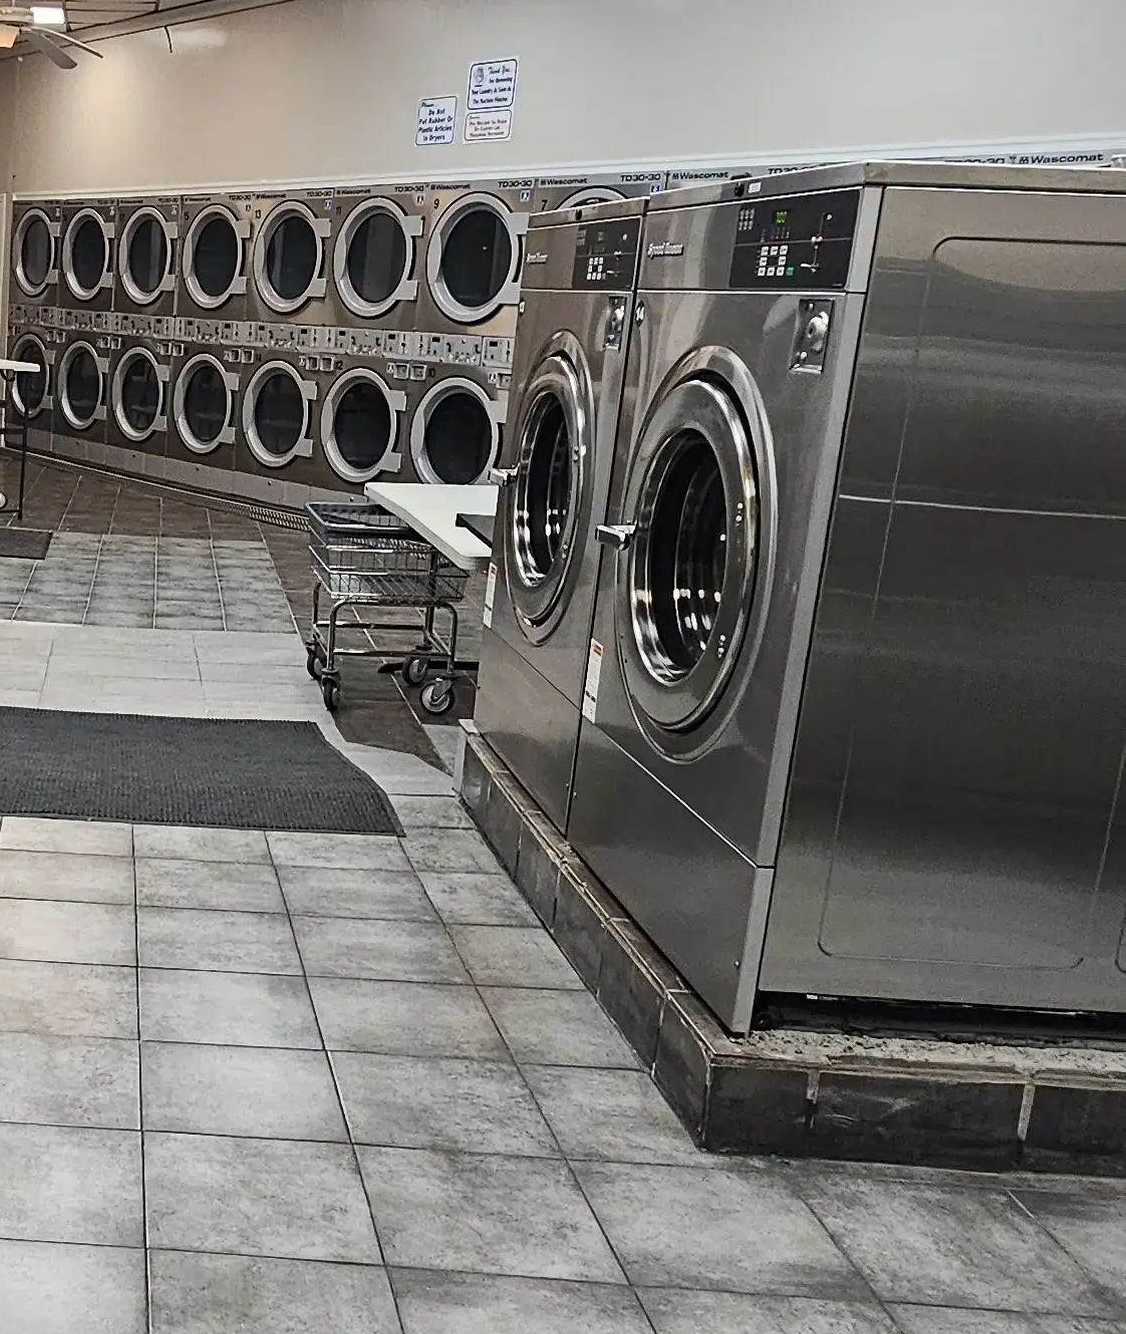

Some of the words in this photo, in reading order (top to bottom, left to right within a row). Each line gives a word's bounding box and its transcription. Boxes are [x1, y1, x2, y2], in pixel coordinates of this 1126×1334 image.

[1031, 153, 1104, 164] Wascomat
[621, 173, 661, 182] TD30-30
[679, 171, 728, 180] Wascomat
[498, 179, 532, 188] TD30-30
[547, 177, 587, 185] Wascomat
[434, 198, 440, 209] 9
[541, 199, 548, 210] 7
